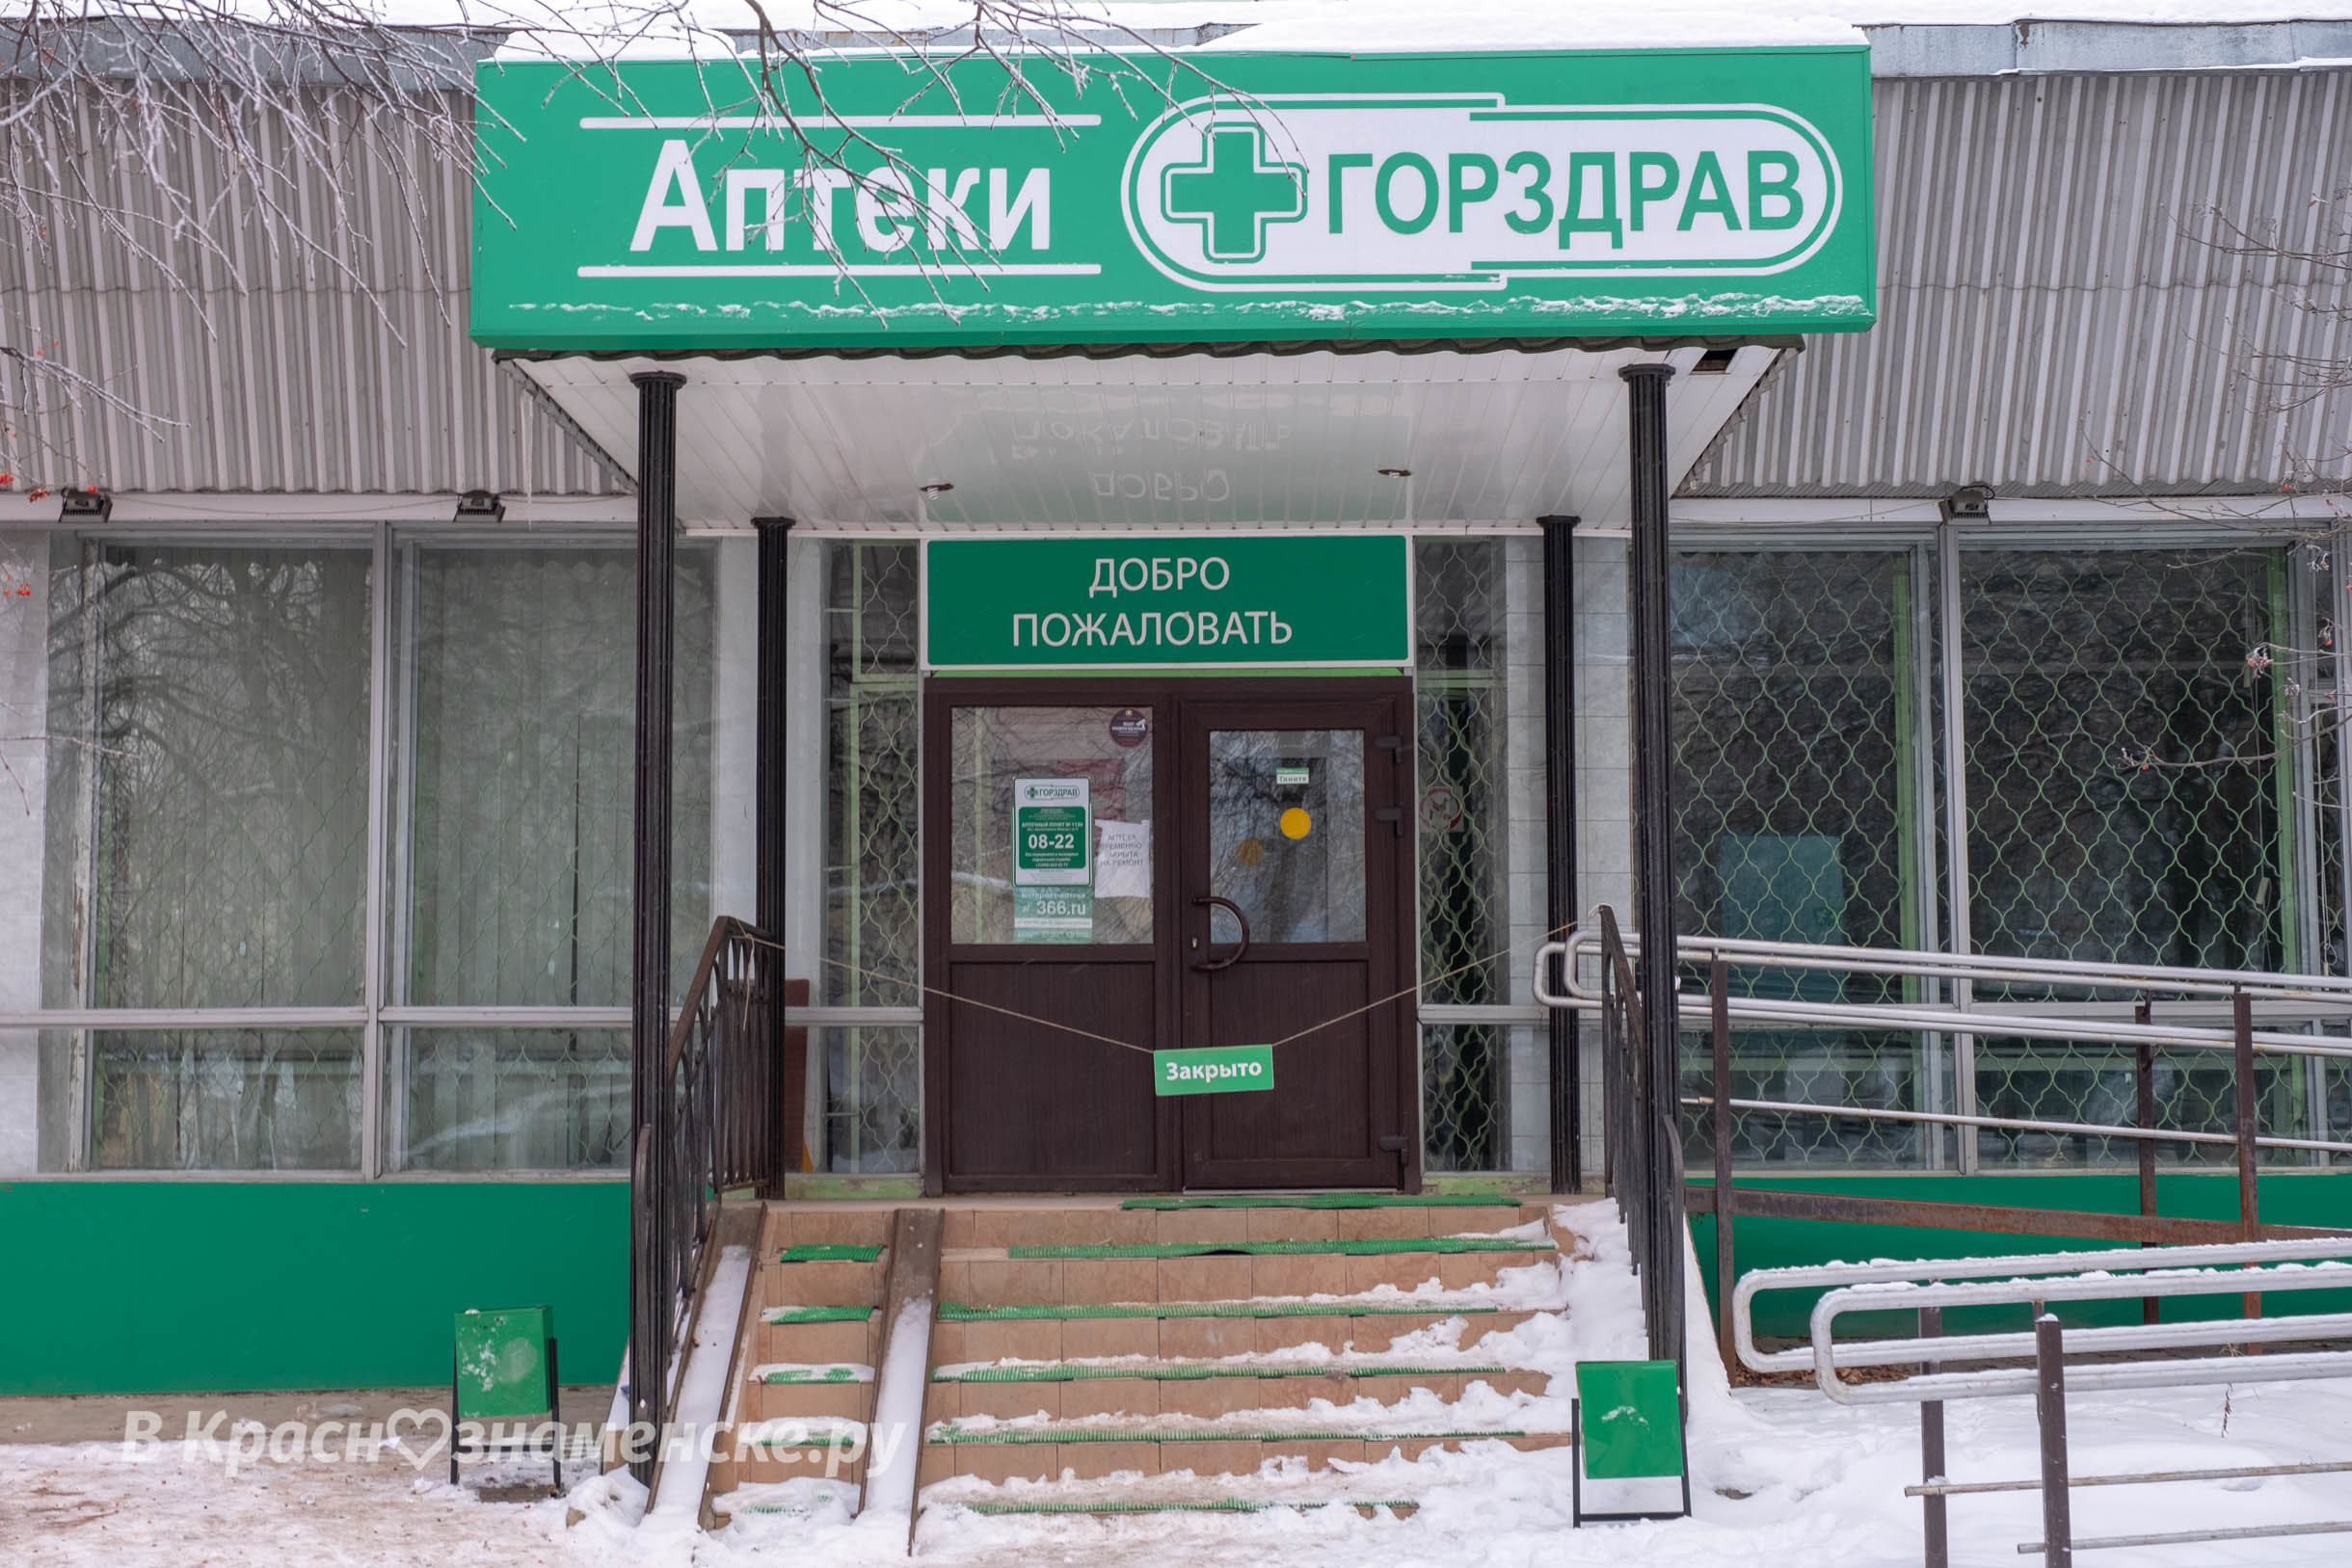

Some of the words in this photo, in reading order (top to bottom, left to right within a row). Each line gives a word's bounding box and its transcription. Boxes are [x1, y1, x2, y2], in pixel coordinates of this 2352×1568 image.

[629, 140, 1052, 252] Аптеки
[1327, 149, 1804, 251] ГОРЗДРАВ
[1088, 556, 1231, 598] ДОБРО
[1011, 610, 1294, 649] ПОЖАЛОВАТЬ
[1038, 787, 1079, 799] ГОРЗДРАВ
[1028, 834, 1075, 850] 08-22
[1036, 900, 1086, 916] 366.ru
[1165, 1061, 1263, 1083] Закрыто
